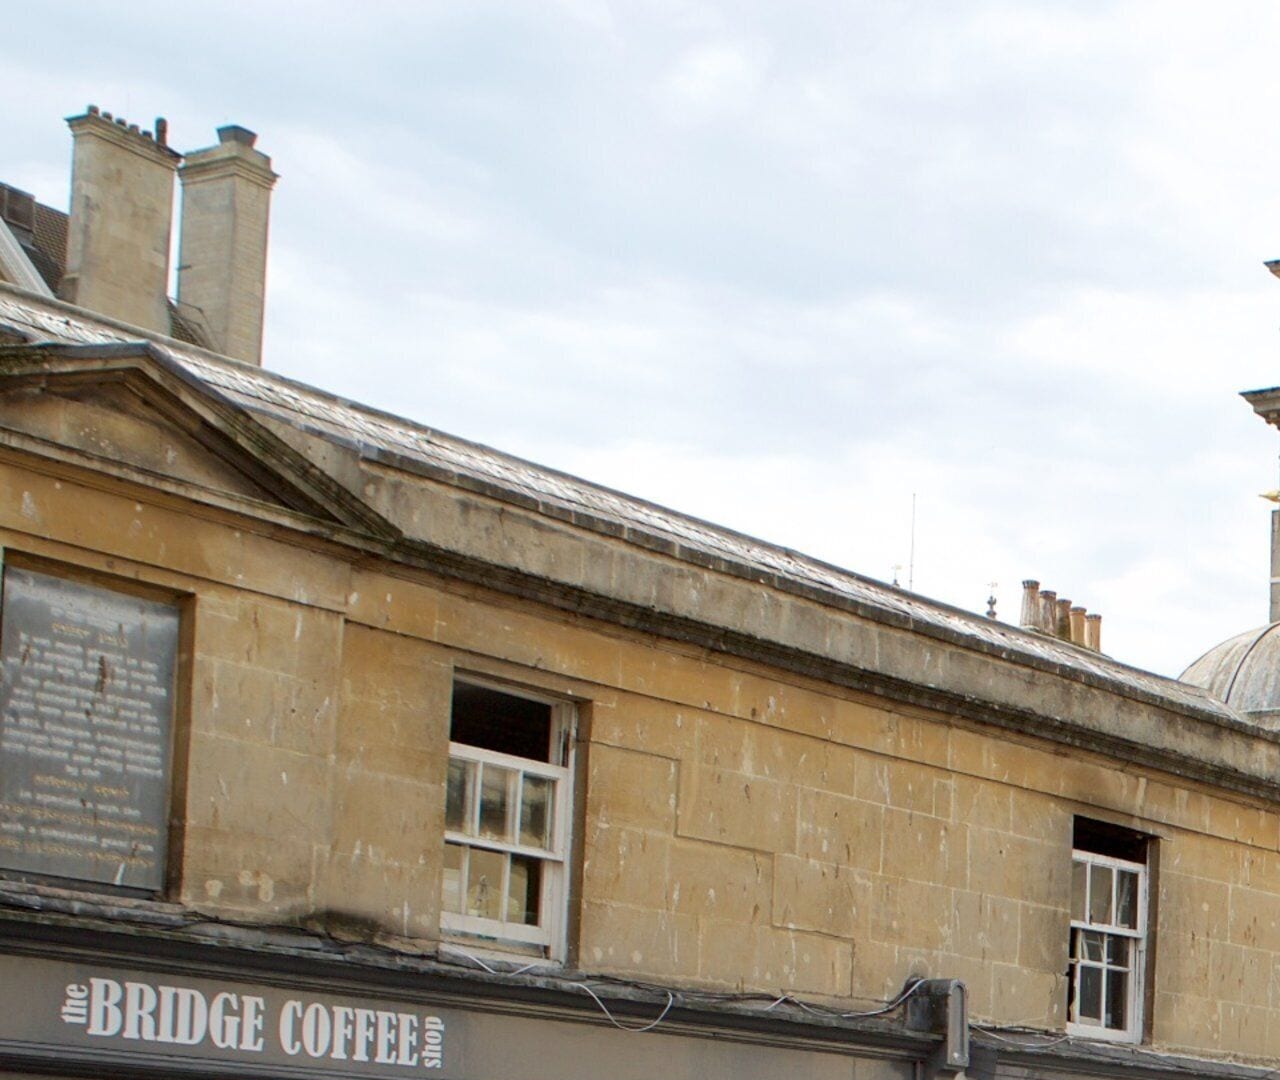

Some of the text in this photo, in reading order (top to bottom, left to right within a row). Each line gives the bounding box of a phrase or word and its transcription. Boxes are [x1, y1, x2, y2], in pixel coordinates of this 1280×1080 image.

[60, 977, 445, 1069] the BRIDGE COFFEE shop
